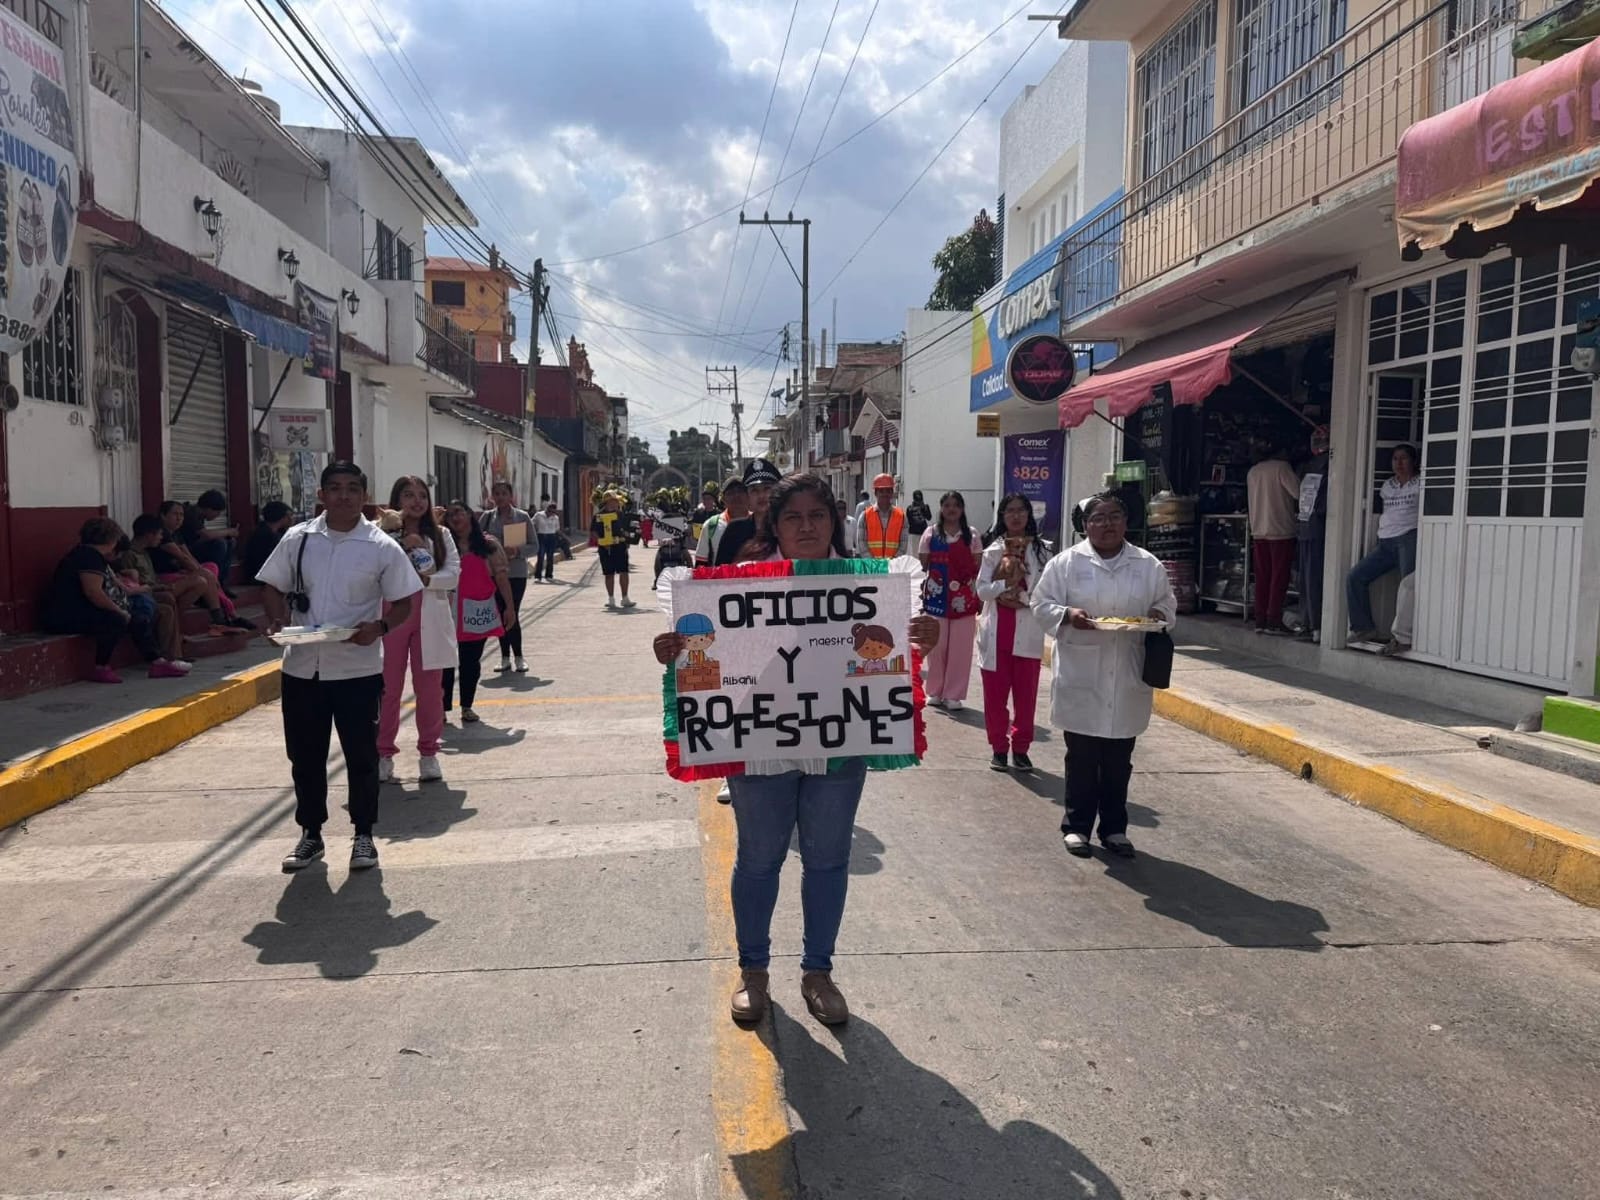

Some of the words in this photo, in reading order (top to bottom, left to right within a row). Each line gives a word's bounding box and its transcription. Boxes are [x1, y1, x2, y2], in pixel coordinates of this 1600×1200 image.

[0, 129, 56, 187] NUDEO
[1018, 438, 1050, 447] Comex
[1013, 466, 1050, 480] $826
[718, 586, 878, 629] OFICIOS
[809, 636, 854, 648] maestra
[777, 645, 801, 684] Y
[722, 674, 757, 686] Albañil
